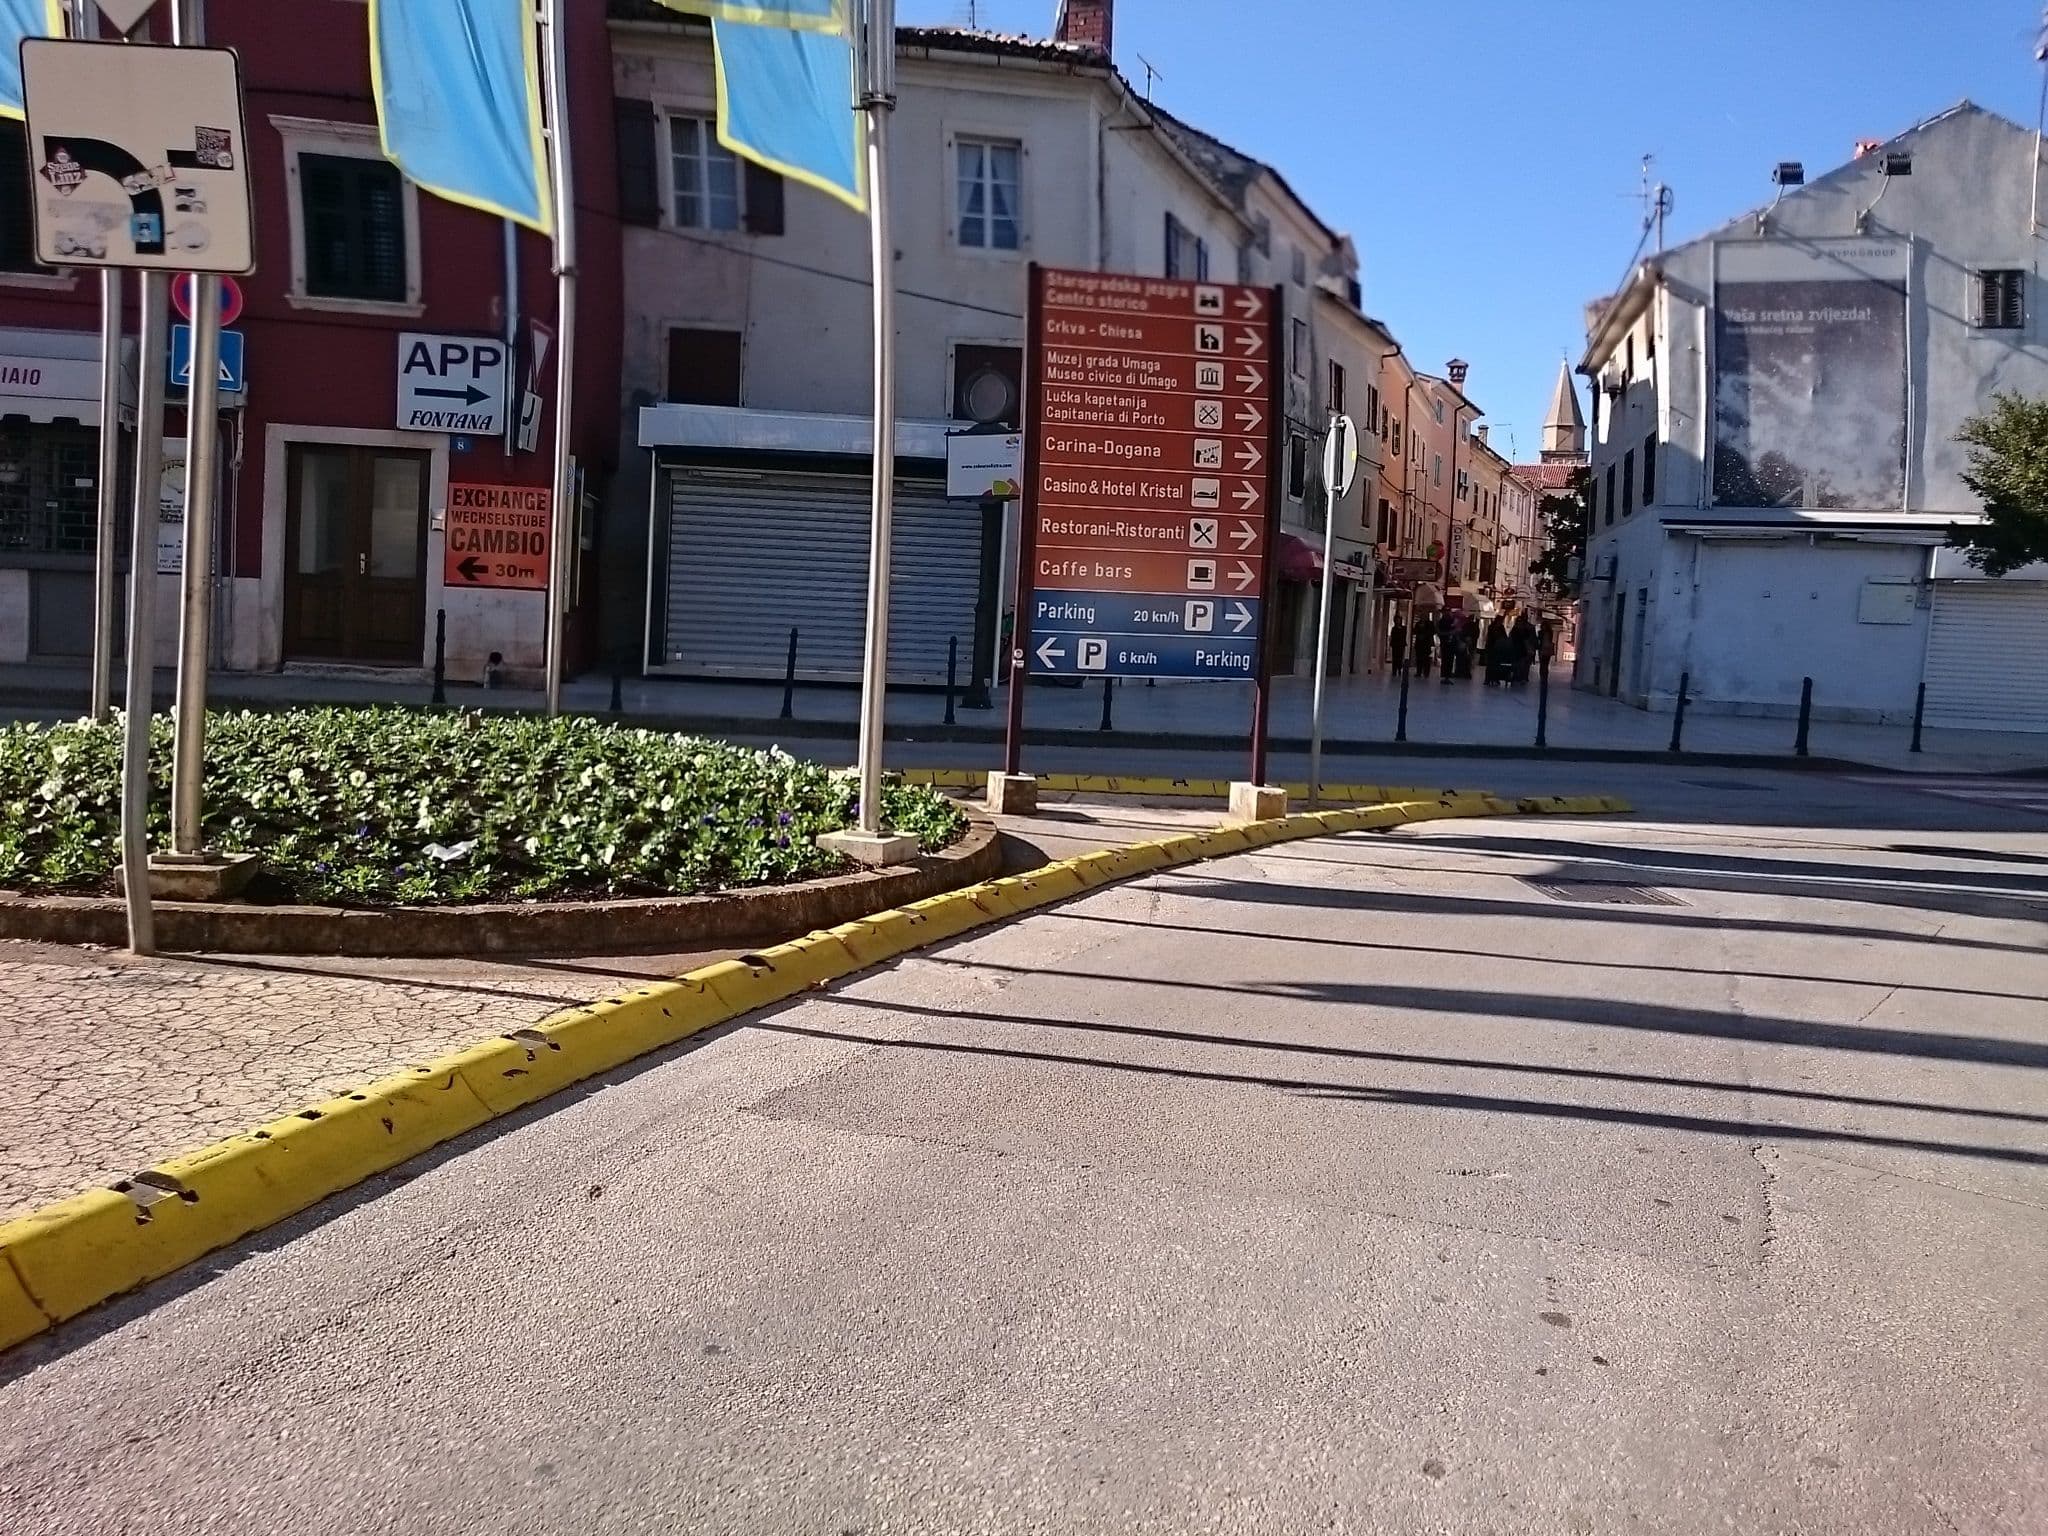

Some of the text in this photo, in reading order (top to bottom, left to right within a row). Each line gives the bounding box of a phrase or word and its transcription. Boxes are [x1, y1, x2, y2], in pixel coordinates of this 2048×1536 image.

[1046, 288, 1148, 310] Centro storico
[1759, 309, 1804, 322] sretna
[1047, 319, 1086, 335] Crkva
[1099, 323, 1142, 339] Chiesa
[403, 341, 502, 379] APP
[1047, 351, 1161, 373] Muzej grada Umaga
[1047, 366, 1178, 390] Museo civico di Umago
[1046, 389, 1147, 410] Lučka kapetanija
[409, 410, 493, 430] FONTANA
[1046, 406, 1166, 425] Capitaneria di Porto
[457, 441, 465, 450] 8
[1045, 436, 1161, 458] Carina-Dogana
[453, 488, 547, 511] EXCHANGE
[1102, 480, 1136, 496] Hotel
[1140, 482, 1184, 498] Kristal
[451, 511, 546, 528] WECHSELSTUBE
[1041, 518, 1185, 540] Restorani-Ristoranti
[451, 527, 545, 556] CAMBIO
[495, 564, 534, 578] 30m
[1040, 560, 1132, 578] Caffe bars
[1037, 602, 1095, 623] Parking
[1133, 610, 1149, 622] 20
[1152, 611, 1179, 624] kn/h
[1119, 652, 1127, 663] 6
[1130, 652, 1157, 664] kn/h
[1195, 650, 1251, 671] Parking
